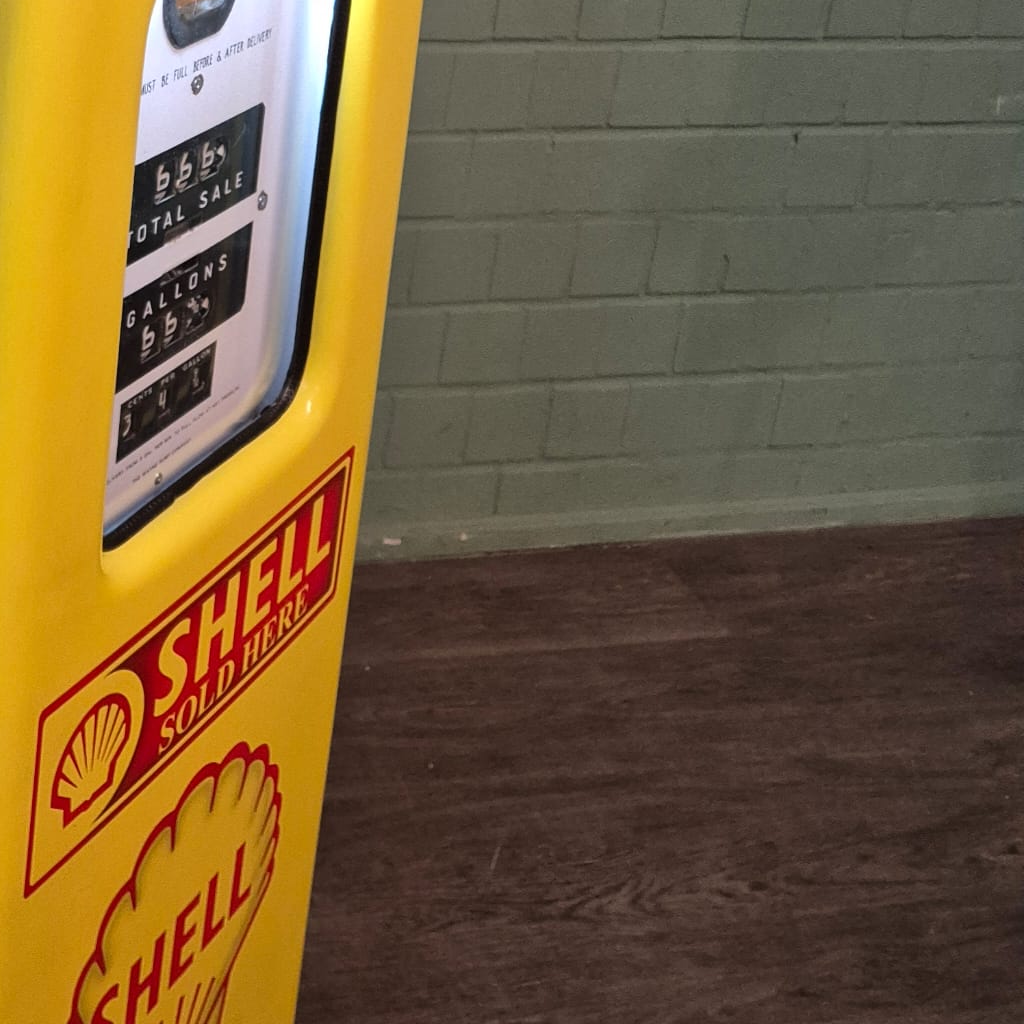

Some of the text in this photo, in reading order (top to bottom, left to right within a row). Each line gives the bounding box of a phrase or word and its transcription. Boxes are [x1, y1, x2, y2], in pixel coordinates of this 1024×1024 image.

[161, 73, 169, 88] BE
[173, 65, 188, 82] FULL
[193, 54, 213, 73] BEFORE
[216, 51, 222, 63] &
[224, 41, 244, 59] AFTER
[247, 28, 273, 49] DELIVERY
[198, 171, 244, 209] SALE
[126, 254, 227, 329] GALLONS
[154, 493, 331, 717] SHELL
[159, 583, 309, 754] SOLD HERE
